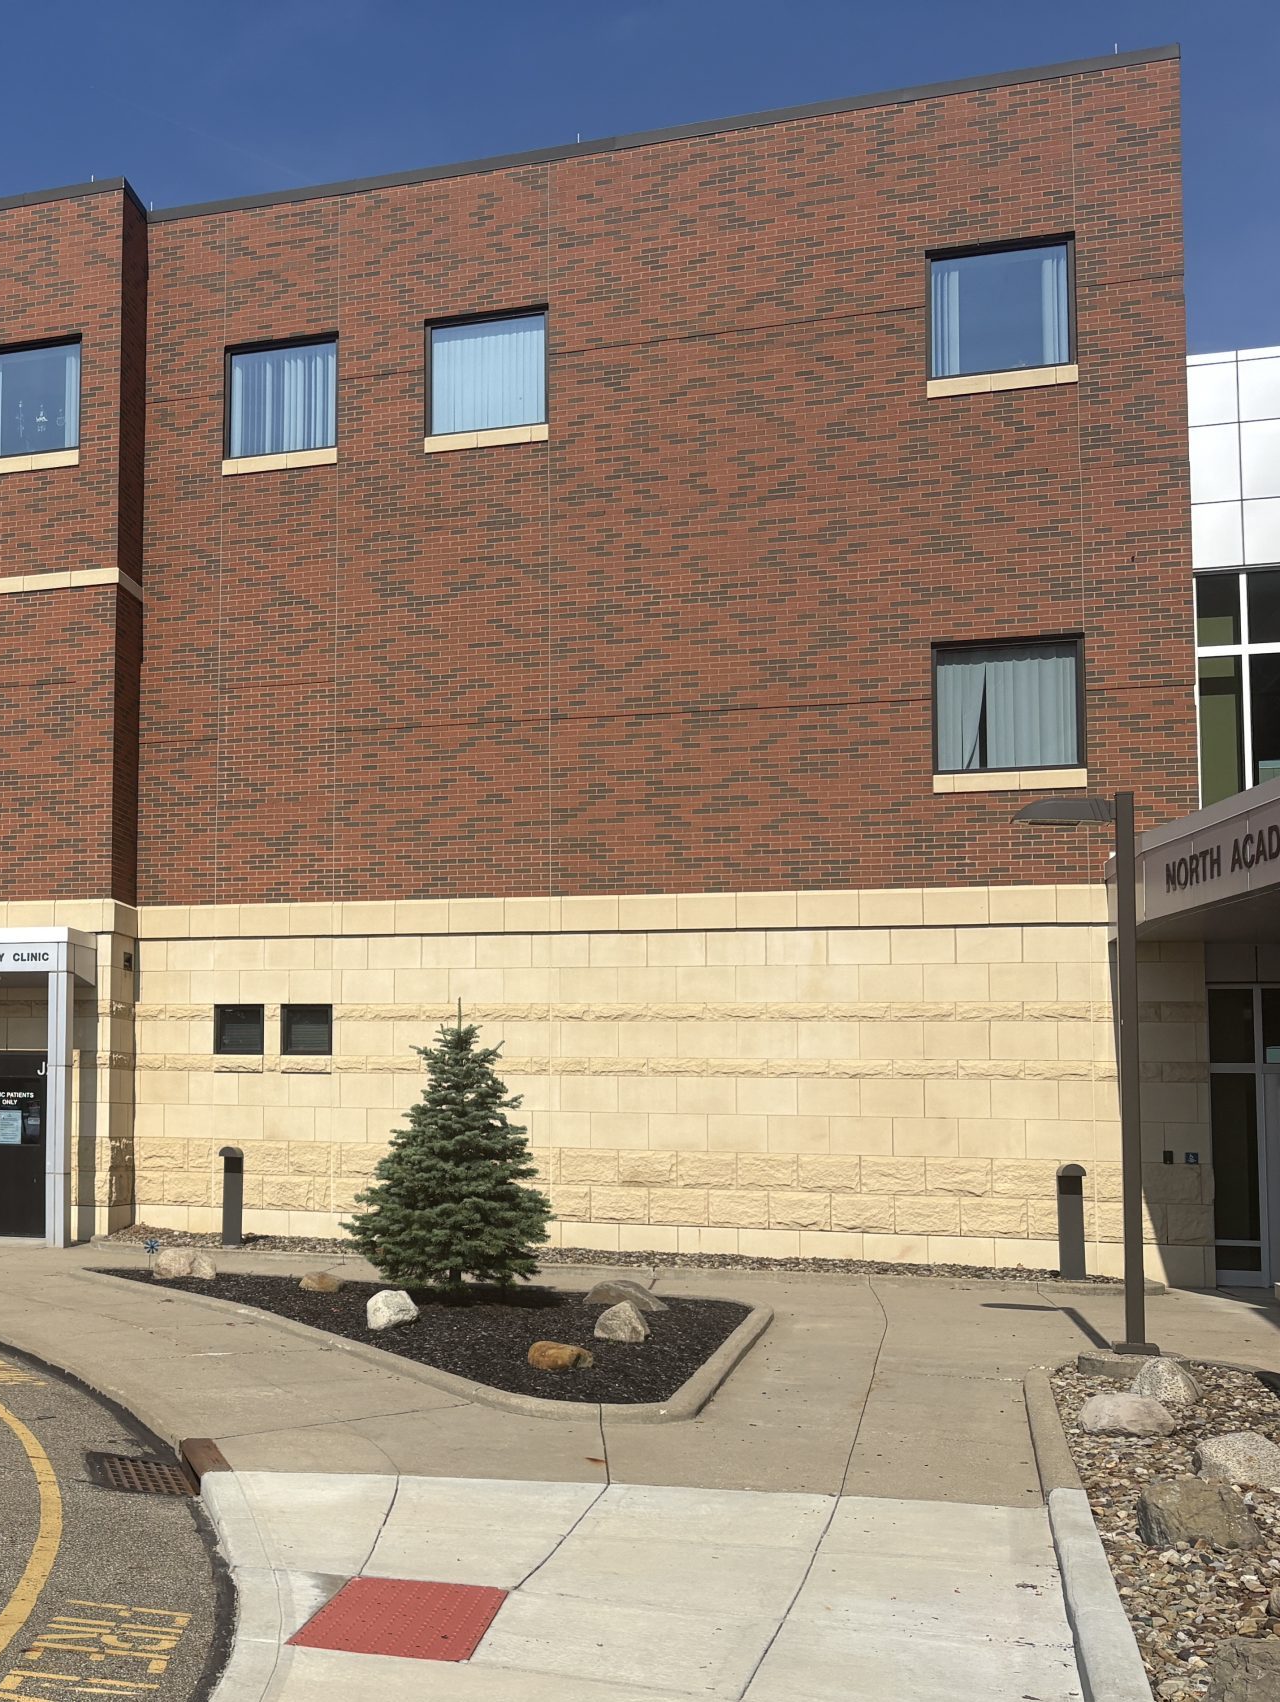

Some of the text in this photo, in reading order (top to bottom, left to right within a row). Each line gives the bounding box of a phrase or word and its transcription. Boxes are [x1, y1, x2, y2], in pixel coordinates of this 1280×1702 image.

[1165, 824, 1280, 893] NORTH ACAD
[12, 952, 50, 962] CLINIC
[37, 1061, 48, 1076] J
[24, 1599, 193, 1674] FIRE
